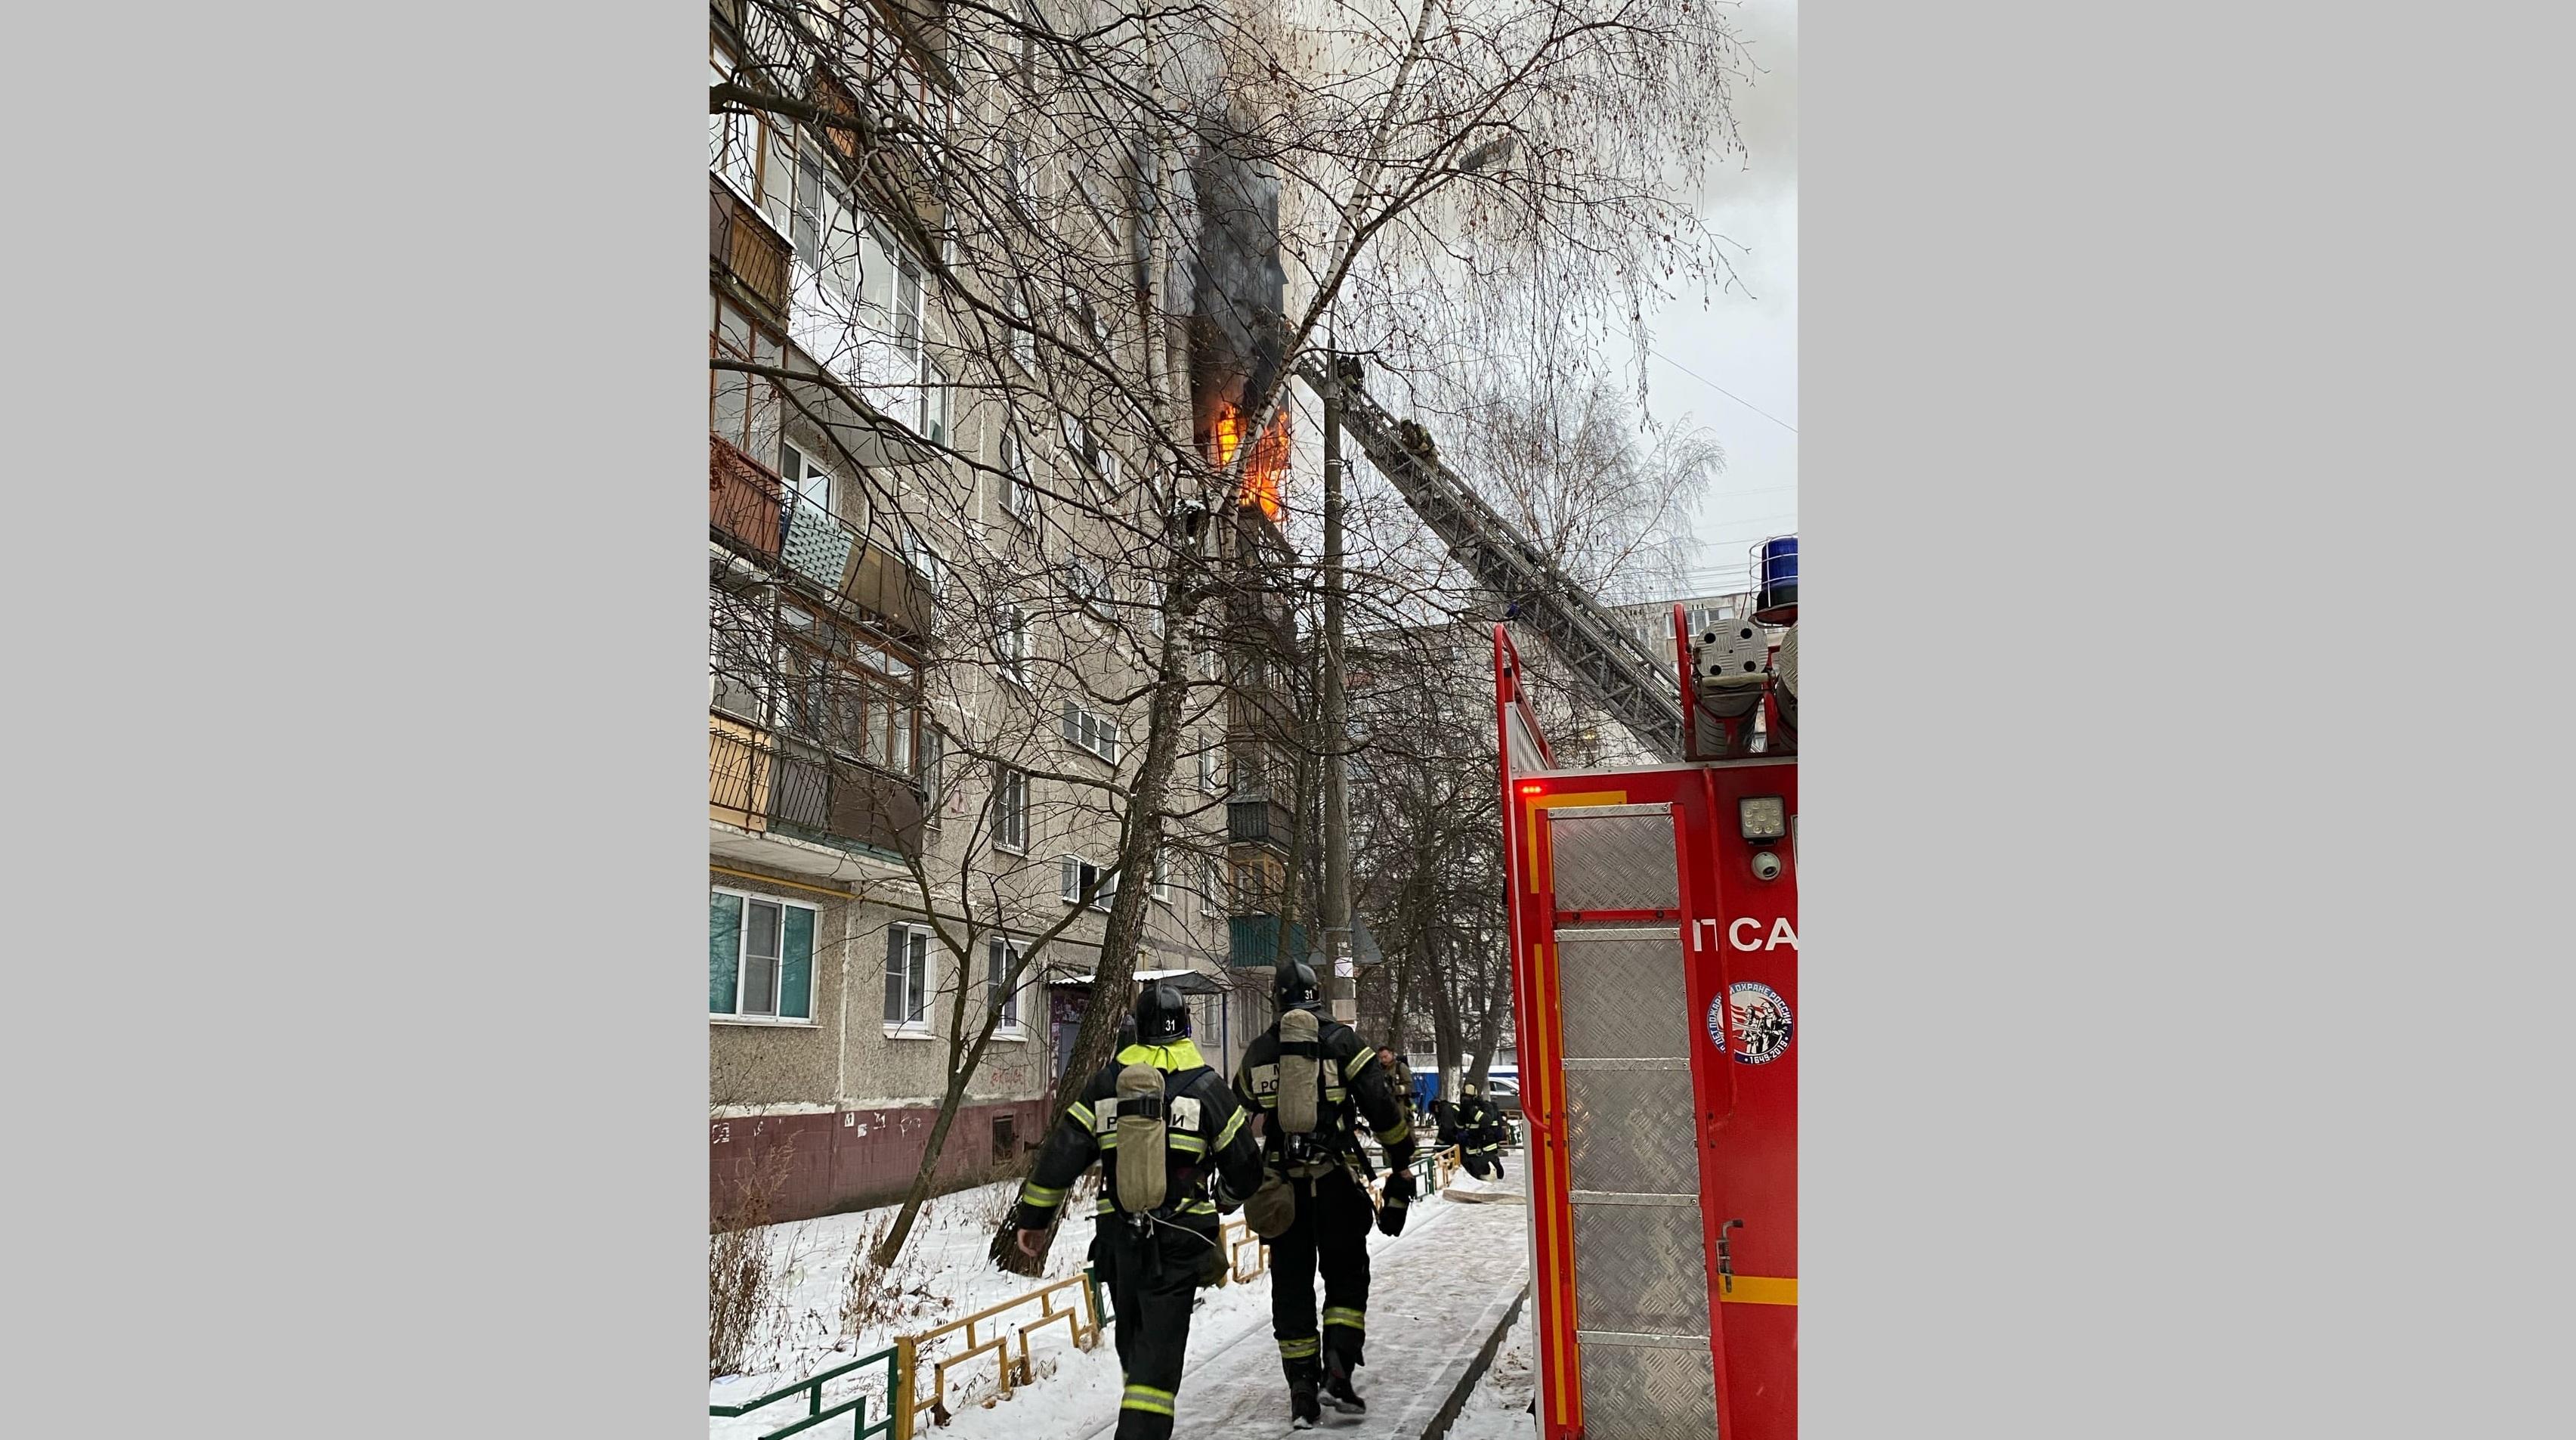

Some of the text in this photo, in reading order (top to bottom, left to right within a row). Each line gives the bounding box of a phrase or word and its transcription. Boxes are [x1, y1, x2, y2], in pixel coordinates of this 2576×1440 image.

[1304, 989, 1313, 1000] 31
[1736, 983, 1770, 995] ОХРАНЕ
[1770, 992, 1792, 1023] РОССИИ
[1165, 1020, 1175, 1031] 31
[1750, 1041, 1787, 1064] 1649-2019
